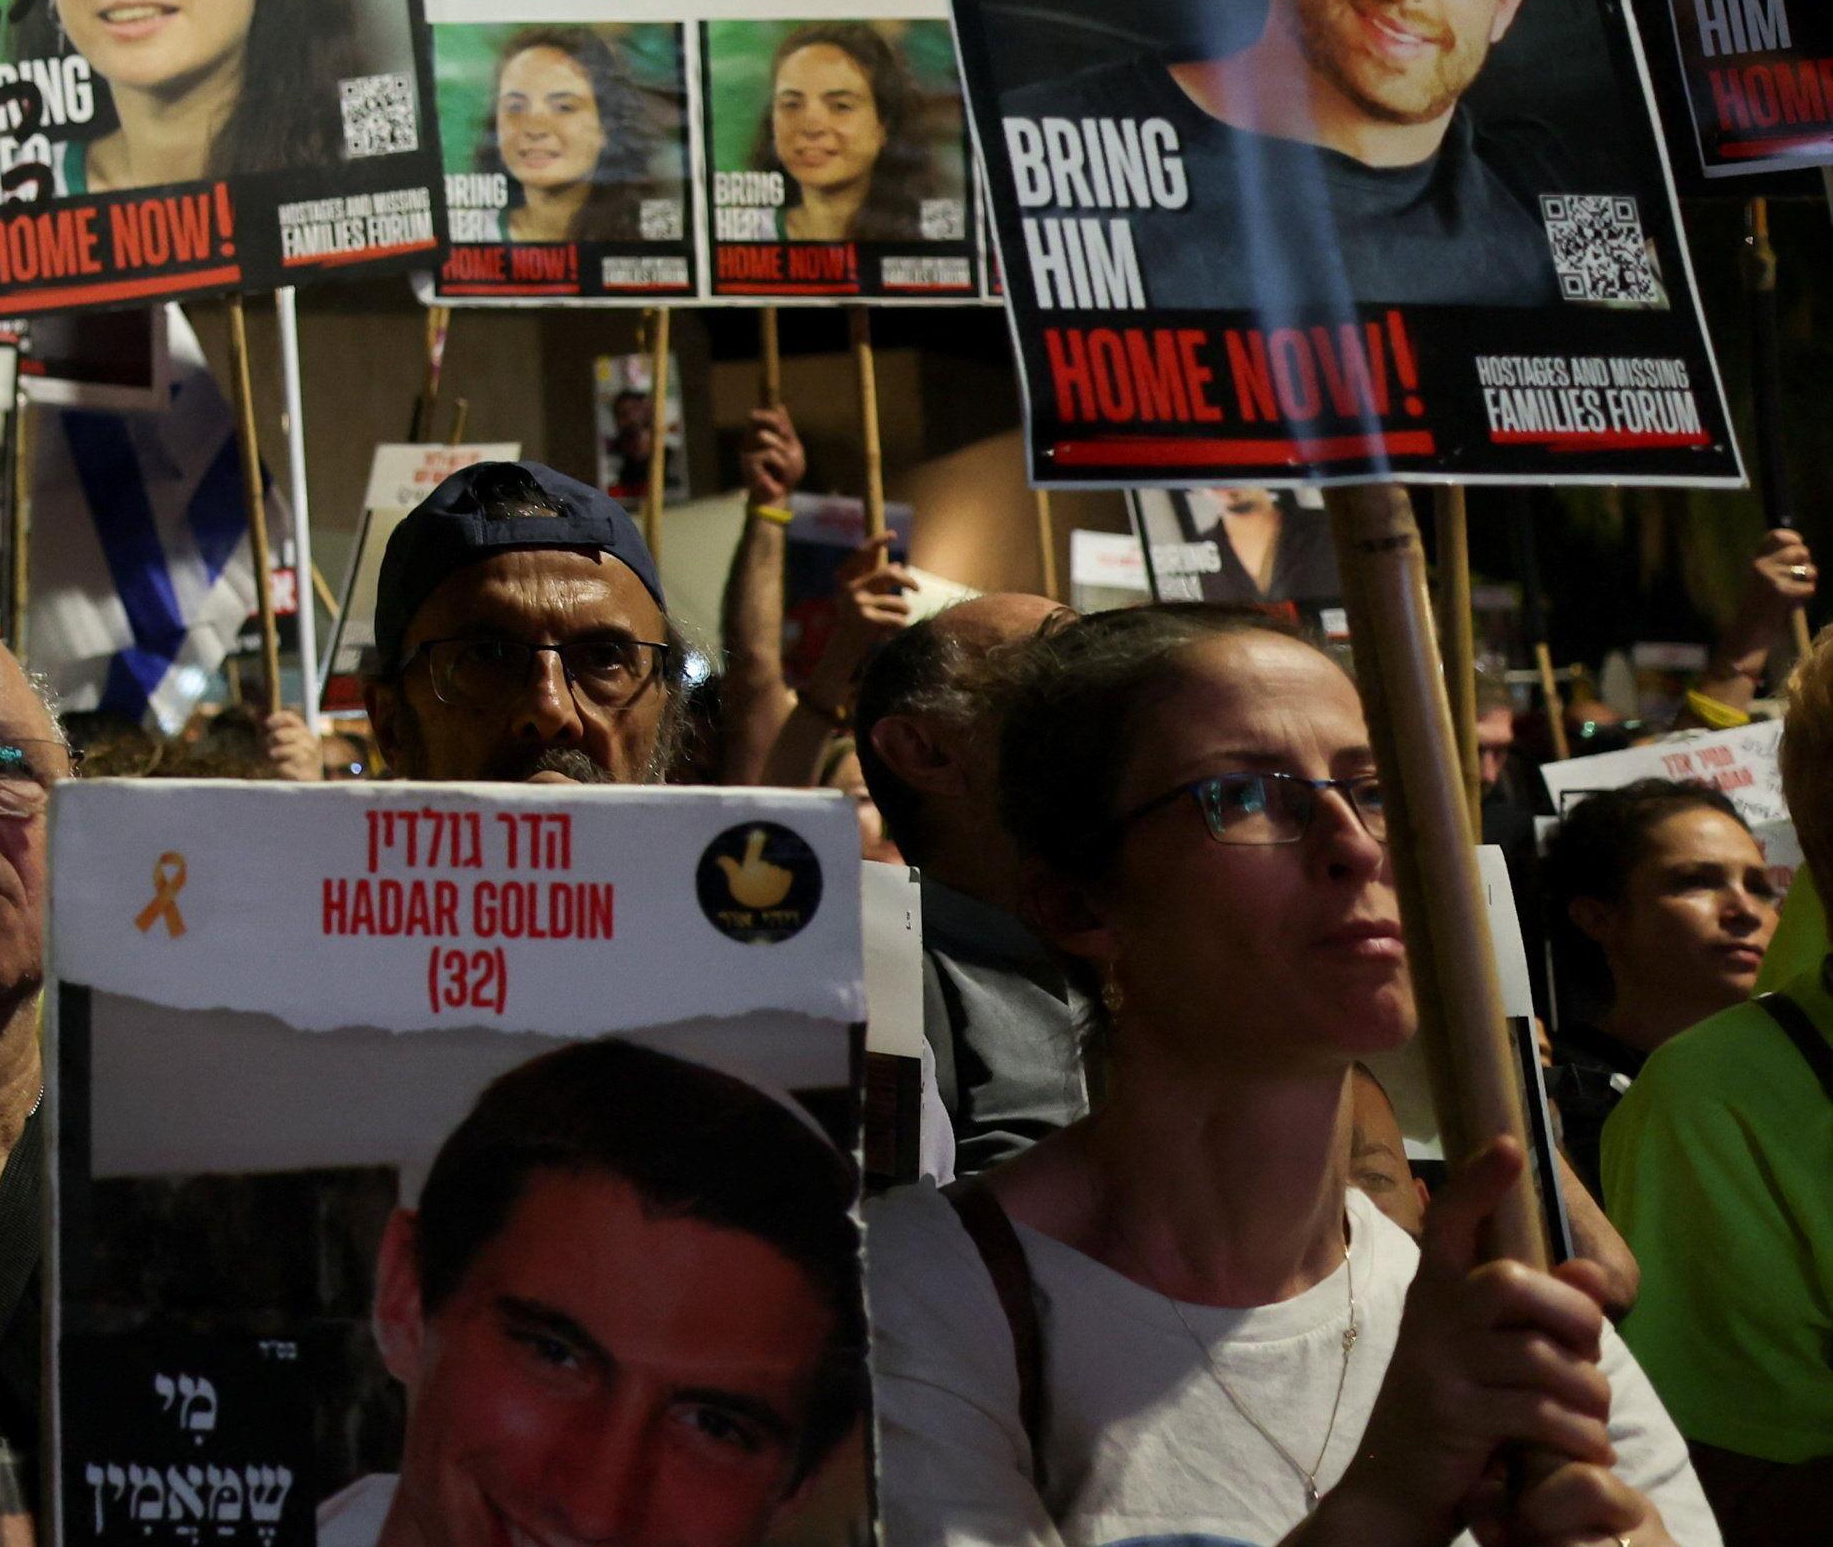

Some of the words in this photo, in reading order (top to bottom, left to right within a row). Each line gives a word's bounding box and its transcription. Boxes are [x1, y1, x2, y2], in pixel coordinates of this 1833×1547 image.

[713, 169, 786, 207] BRING
[1001, 115, 1190, 212] BRING
[110, 182, 236, 274] NOW!
[717, 245, 784, 281] HOME
[1020, 215, 1149, 312] HIM
[1044, 326, 1221, 424] HOME
[1223, 308, 1424, 423] NOW!
[1475, 353, 1568, 391] HOSTAGES
[1570, 356, 1610, 391] AND
[1610, 357, 1690, 391] MISSING
[1483, 385, 1596, 434] FAMILIES
[1599, 389, 1703, 436] FORUM
[366, 808, 483, 875] גולדין
[497, 812, 573, 871] הדר
[322, 878, 461, 938] HADAR
[473, 883, 614, 942] GOLDIN
[428, 948, 509, 1015] (32)
